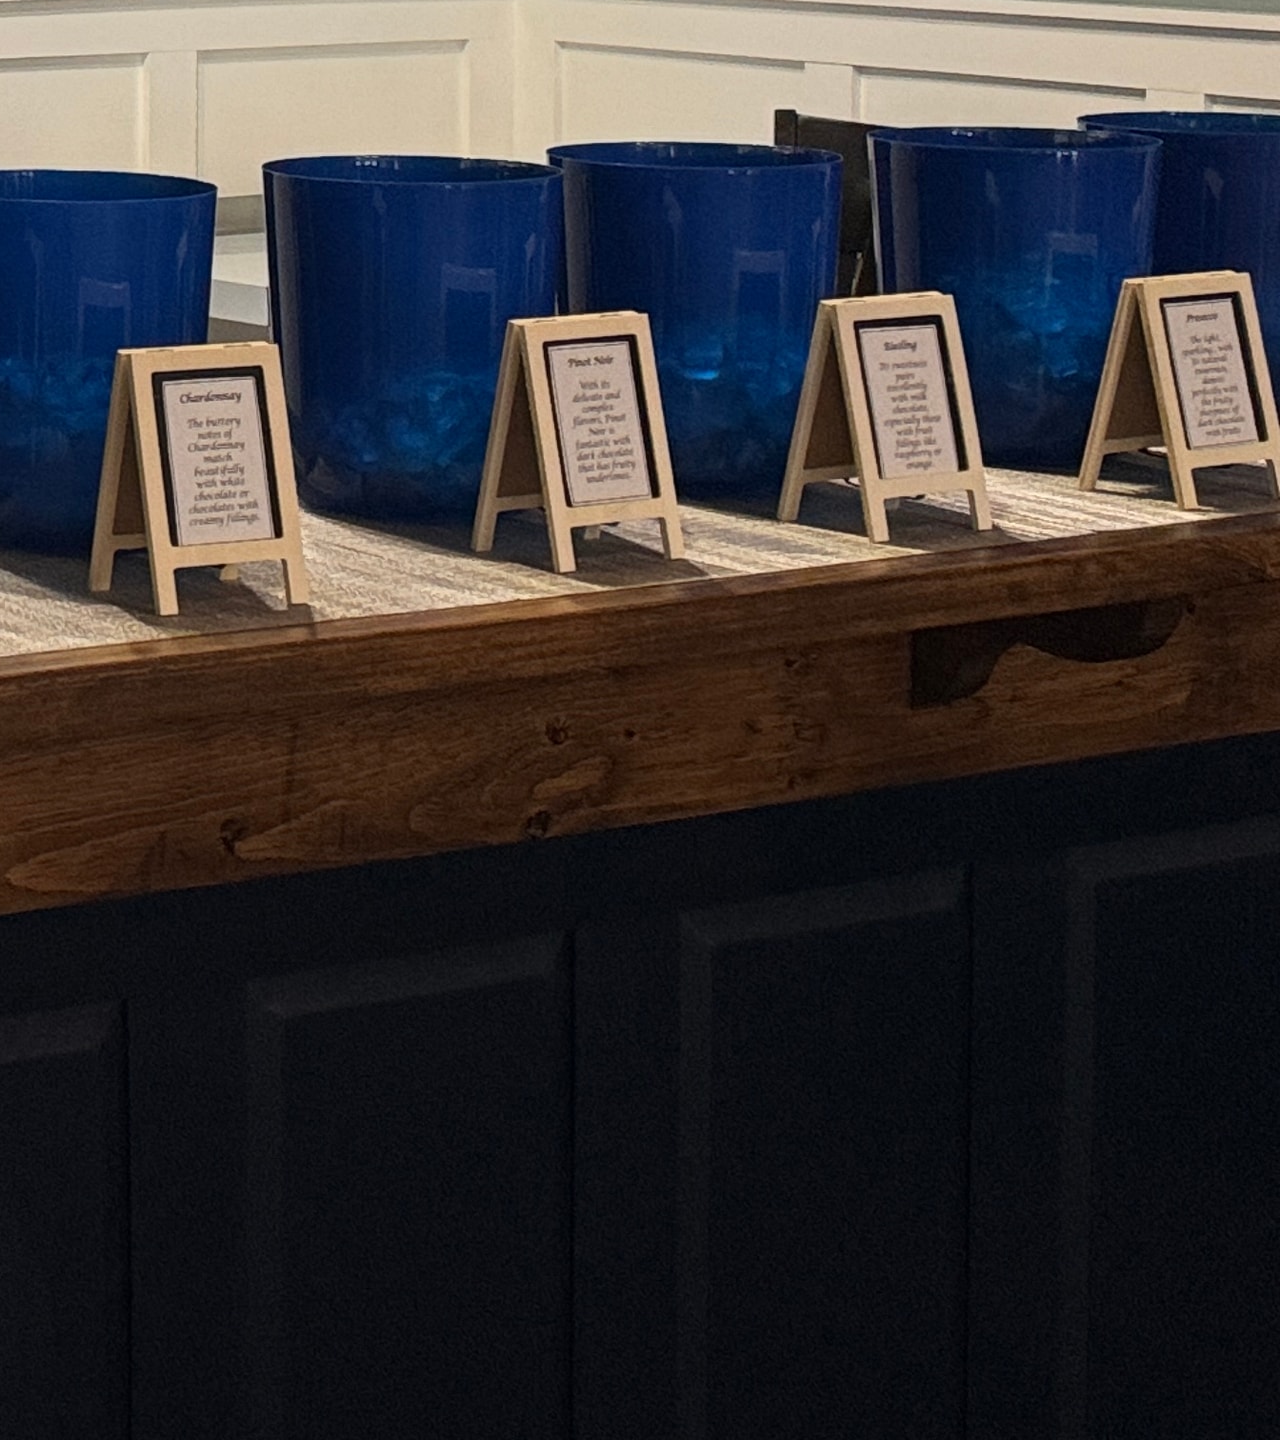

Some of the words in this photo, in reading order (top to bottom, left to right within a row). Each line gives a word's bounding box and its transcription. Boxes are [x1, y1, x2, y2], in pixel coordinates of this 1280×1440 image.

[568, 358, 591, 368] Pinot
[594, 356, 614, 366] Noir
[180, 390, 242, 404] Chardonnay
